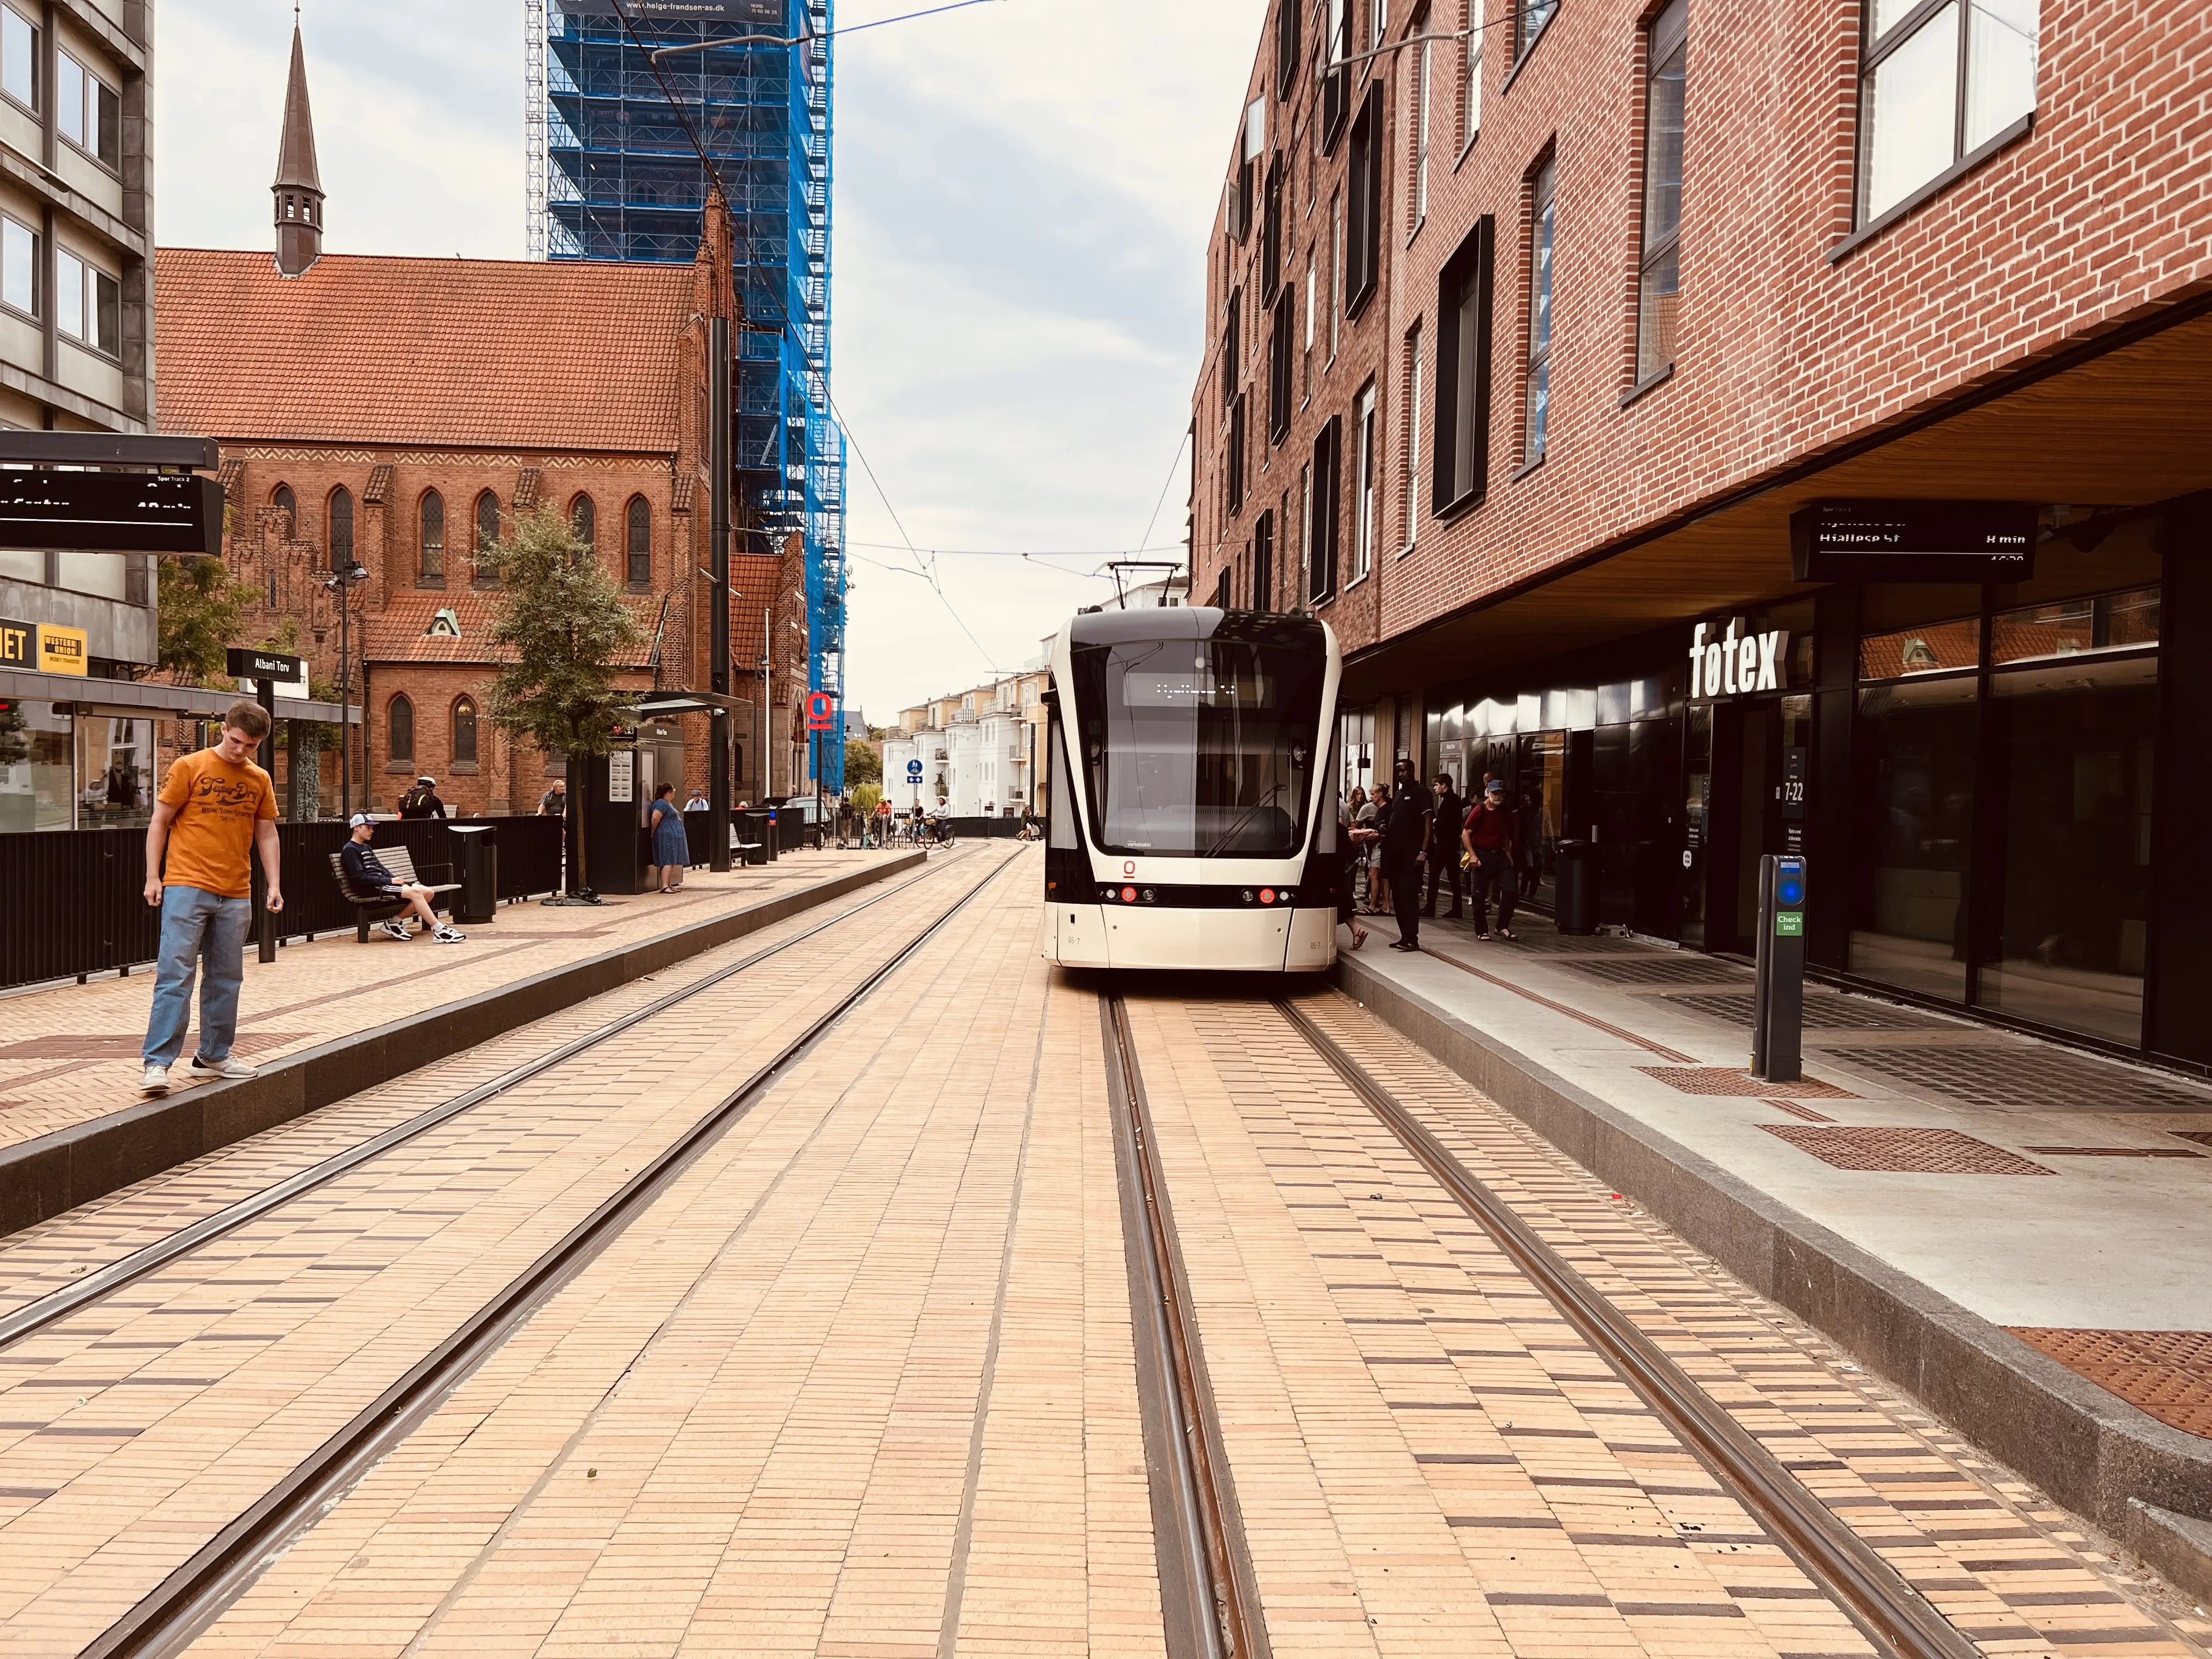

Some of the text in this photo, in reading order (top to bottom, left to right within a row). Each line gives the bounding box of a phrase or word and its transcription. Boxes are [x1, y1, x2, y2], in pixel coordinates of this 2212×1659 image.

[0, 628, 26, 661] ET
[46, 636, 76, 647] WESTERN
[54, 645, 76, 655] UNION
[255, 658, 290, 673] Albani Torv
[1689, 617, 1780, 698] føtex
[1785, 782, 1803, 801] 7-22
